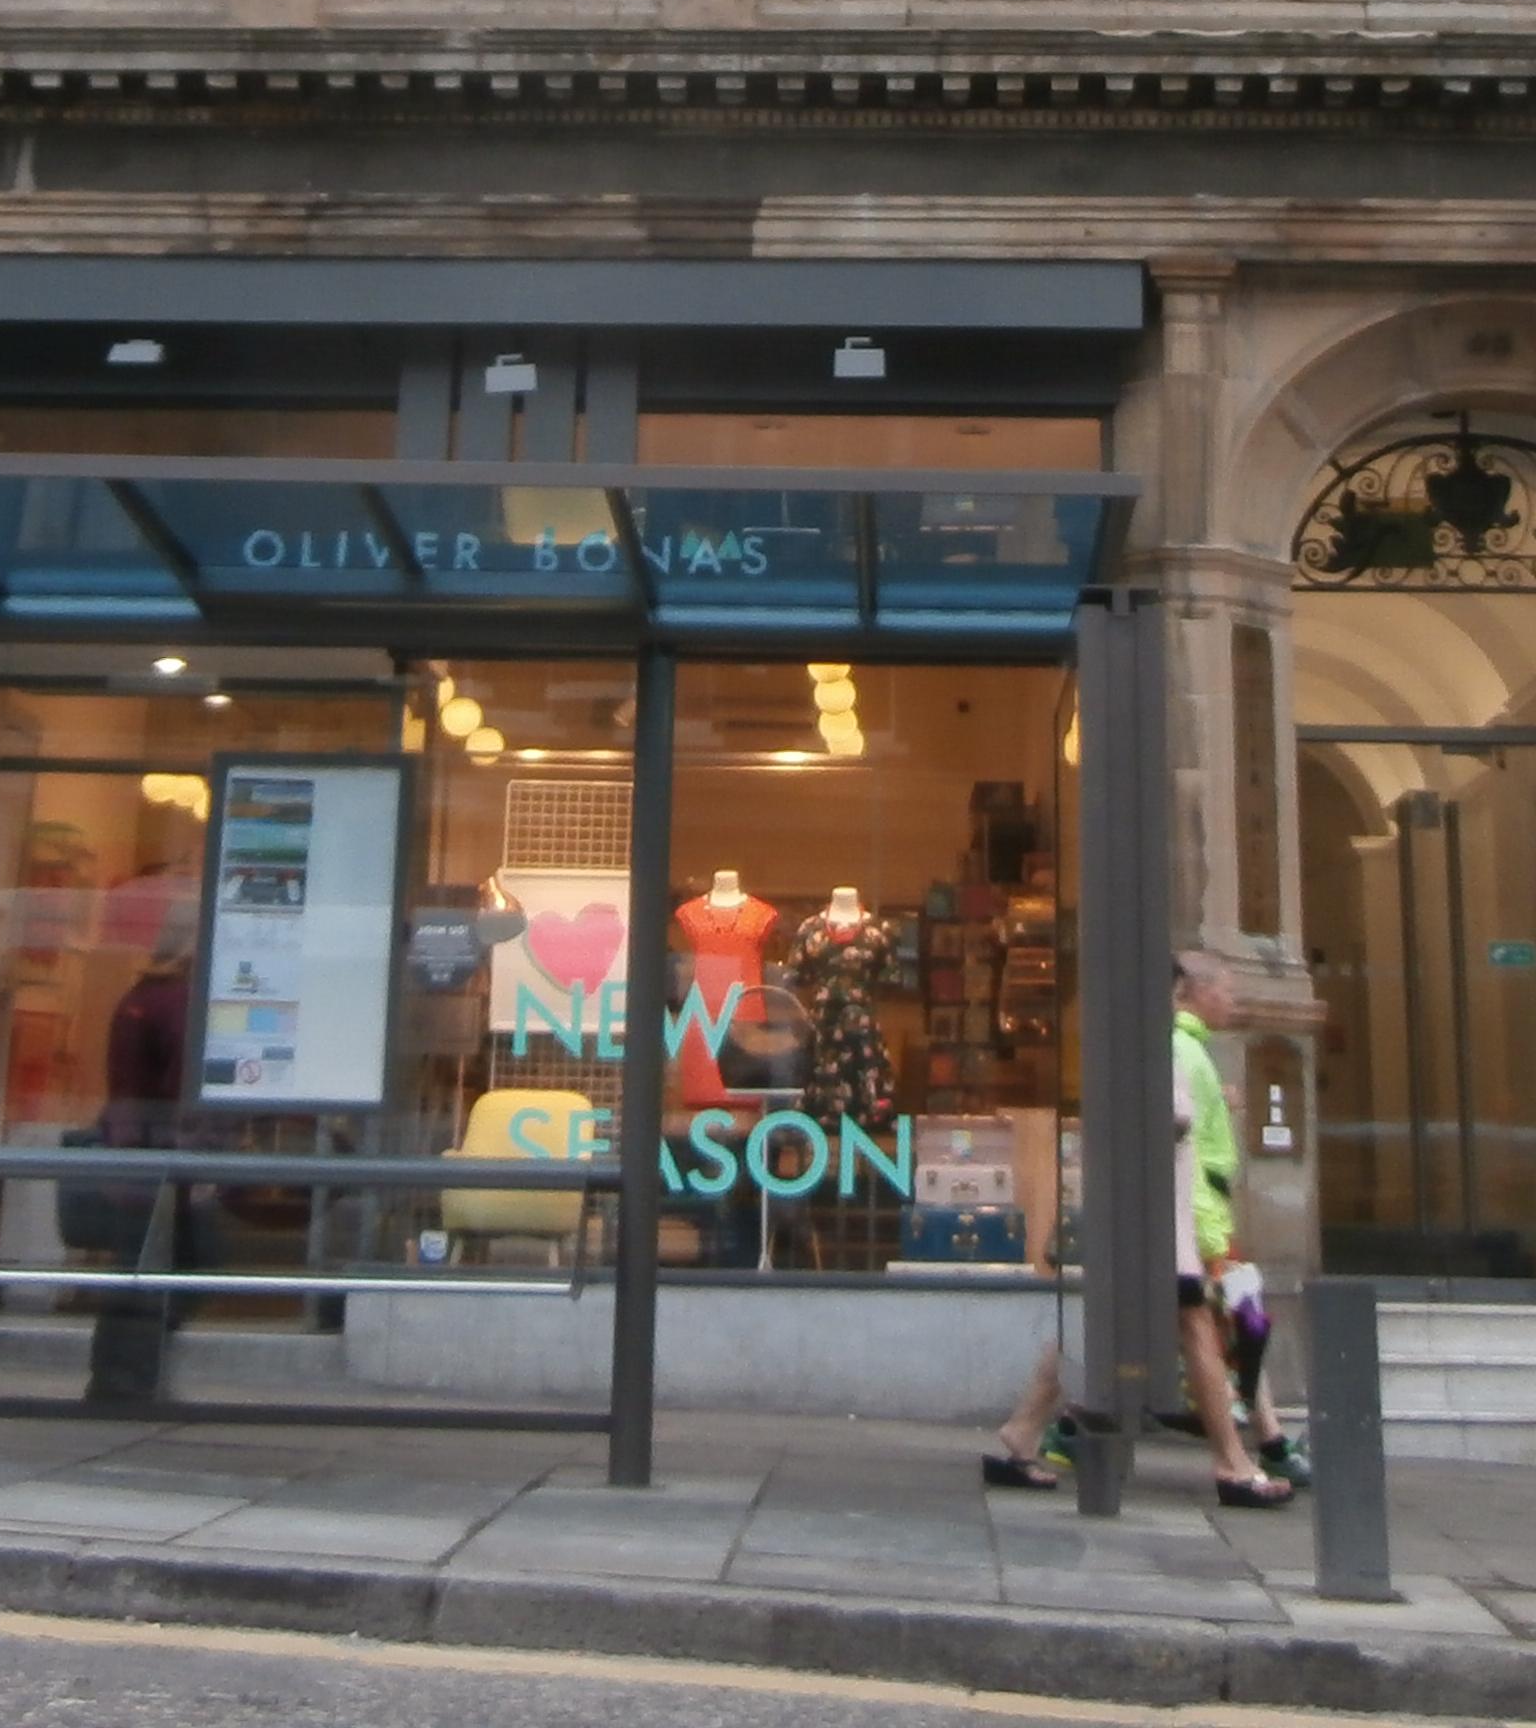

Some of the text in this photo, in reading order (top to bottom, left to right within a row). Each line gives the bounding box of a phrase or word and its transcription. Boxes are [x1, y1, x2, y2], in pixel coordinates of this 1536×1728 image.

[243, 528, 769, 575] OLIVER BONAS
[511, 977, 746, 1060] NEW
